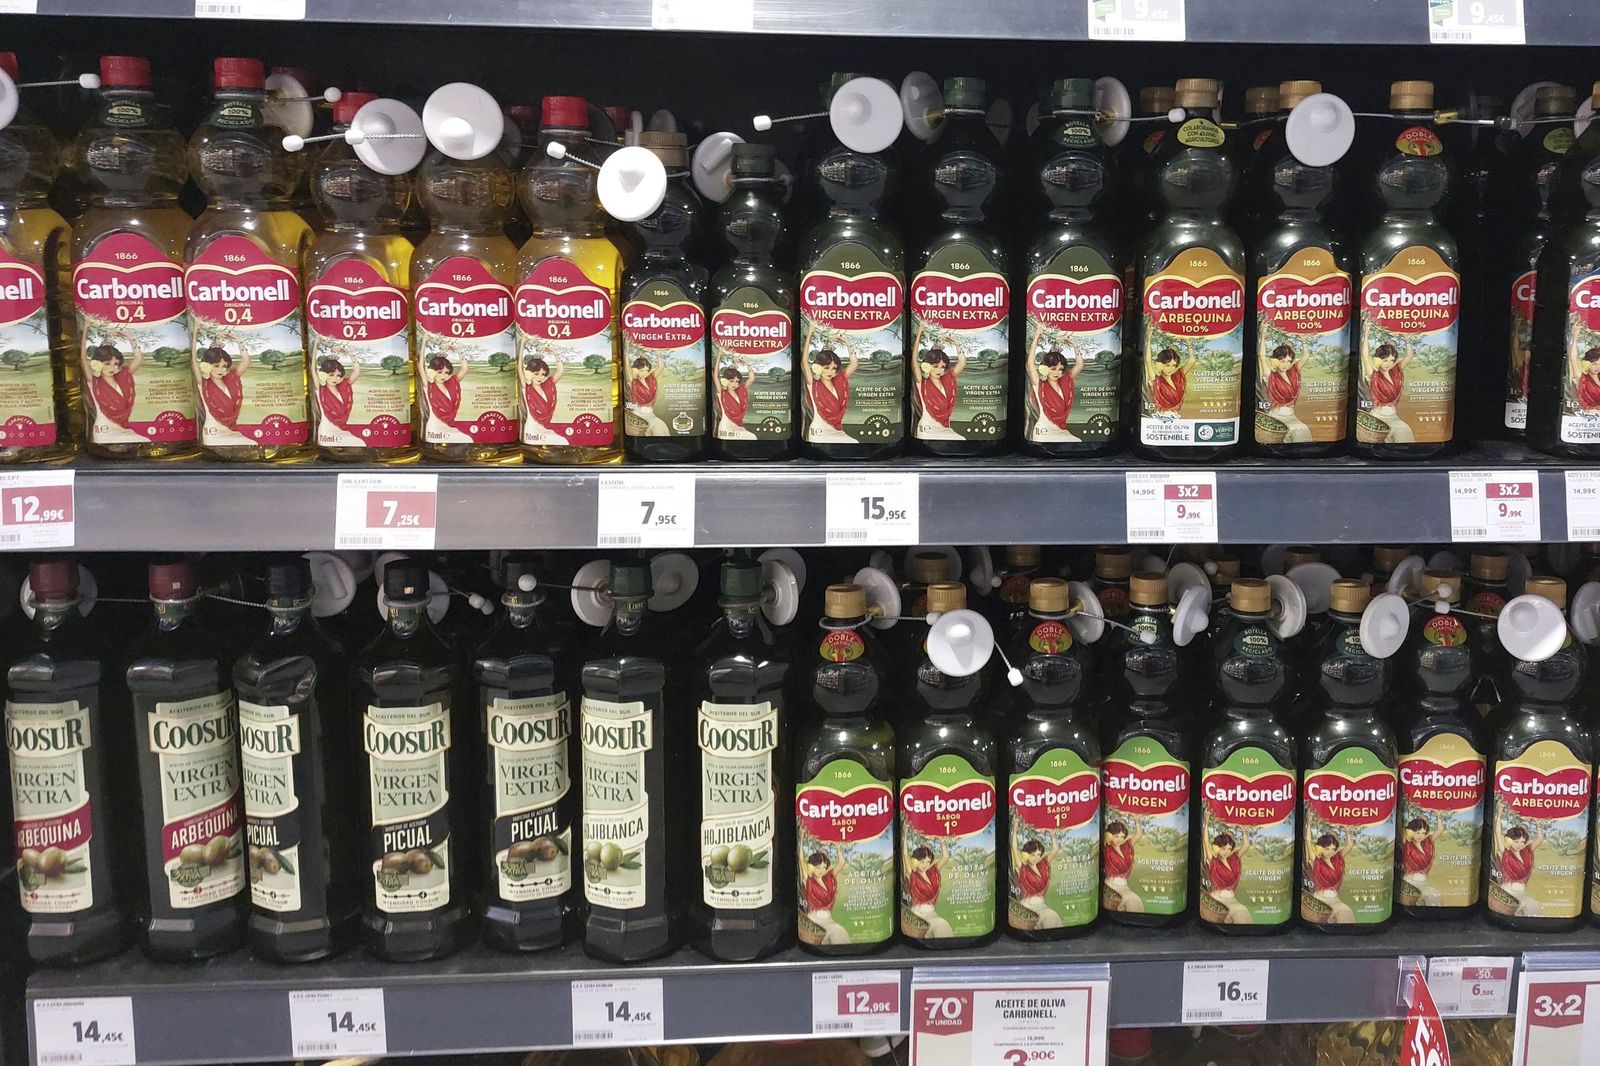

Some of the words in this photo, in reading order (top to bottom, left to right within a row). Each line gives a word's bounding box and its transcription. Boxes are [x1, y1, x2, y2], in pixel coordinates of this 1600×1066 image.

[115, 252, 138, 260] 1866
[223, 254, 246, 262] 1866
[1189, 260, 1208, 268] 1866
[1303, 259, 1321, 267] 1866
[840, 262, 861, 270] 1866
[950, 263, 970, 271] 1866
[1069, 264, 1089, 273] 1866
[343, 276, 364, 285] 1866
[452, 274, 473, 283] 1866
[548, 276, 568, 284] 1866
[77, 277, 184, 299] Carbonell
[188, 279, 290, 301] Carbonell
[653, 289, 669, 297] 1866
[804, 285, 896, 308] Carbonell
[915, 286, 1004, 307] Carbonell
[1031, 288, 1120, 309] Carbonell
[1148, 289, 1241, 309] Carbonell
[1261, 288, 1350, 308] Carbonell
[1365, 287, 1457, 307] Carbonell
[310, 299, 401, 320] Carbonell
[418, 296, 508, 318] Carbonell
[517, 298, 604, 320] Carbonell
[743, 301, 759, 309] 1866
[116, 306, 146, 322] 0,4
[224, 307, 253, 323] 0,4
[624, 312, 701, 329] Carbonell
[811, 309, 851, 320] VIRGEN
[854, 310, 891, 320] EXTRA
[921, 309, 961, 320] VIRGEN
[962, 310, 999, 320] EXTRA
[1038, 311, 1079, 322] VIRGEN
[1080, 311, 1115, 322] EXTRA
[1158, 313, 1232, 324] ARBEQUINA
[1273, 310, 1344, 321] ARBEQUINA
[1376, 309, 1450, 320] ARBEQUINA
[342, 324, 368, 340] 0,4
[451, 322, 476, 337] 0,4
[547, 324, 572, 339] 0,4
[715, 320, 787, 339] Carbonell
[1181, 325, 1209, 333] 100%
[1296, 322, 1323, 330] 100%
[1399, 321, 1426, 329] 100%
[632, 331, 663, 342] VIRGEN
[665, 331, 693, 341] EXTRA
[718, 338, 752, 348] VIRGEN
[752, 339, 784, 349] EXTRA
[1145, 433, 1190, 441] SOSTENIBLE
[1177, 485, 1199, 497] 3x2
[1498, 483, 1520, 496] 3x2
[11, 495, 64, 523] 12,99€
[383, 500, 420, 527] 7,25€
[640, 501, 677, 526] 7,95€
[860, 496, 906, 521] 15,95€
[1176, 504, 1201, 519] 9,99€
[1498, 502, 1522, 518] 9,99€
[1249, 636, 1267, 645] 100%
[153, 707, 237, 749] COOSUR
[491, 707, 570, 745] COOSUR
[366, 719, 447, 755] COOSUR
[699, 719, 774, 751] COOSUR
[1439, 743, 1456, 751] 1866
[1539, 751, 1556, 759] 1866
[500, 758, 564, 780] VIRGEN
[1050, 760, 1067, 768] 1866
[1242, 757, 1259, 765] 1866
[1346, 757, 1363, 765] 1866
[167, 759, 234, 785] VIRGEN
[706, 769, 766, 787] VIRGEN
[834, 771, 852, 779] 1866
[939, 766, 957, 774] 1866
[1400, 768, 1484, 788] Carbonell
[243, 771, 287, 789] IRGEN
[374, 770, 440, 791] VIRGEN
[505, 776, 562, 797] EXTRA
[1102, 769, 1186, 792] Carbonell
[1498, 774, 1588, 796] Carbonell
[174, 778, 234, 802] EXTRA
[244, 788, 284, 806] XTRA
[379, 789, 437, 807] EXTRA
[585, 783, 634, 802] EXTRA
[709, 785, 763, 803] EXTRA
[1012, 781, 1098, 807] Carbonell
[1205, 782, 1292, 803] Carbonell
[1307, 782, 1394, 803] Carbonell
[1412, 788, 1478, 801] ARBEQUINA
[799, 795, 889, 818] Carbonell
[903, 790, 992, 814] Carbonell
[1117, 794, 1168, 808] VIRGEN
[1512, 797, 1580, 809] ARBEQUINA
[936, 813, 961, 821] SABOR
[1046, 805, 1070, 814] SABOR
[1224, 806, 1275, 818] VIRGEN
[1328, 806, 1379, 818] VIRGEN
[171, 807, 238, 850] ARBEQUINA
[511, 812, 559, 843] PICUAL
[704, 815, 771, 845] HOJIBLANCA
[831, 818, 857, 826] SABOR
[247, 825, 280, 847] PICUAL
[383, 825, 433, 853] PICUAL
[1218, 981, 1258, 1002] 16,15€
[846, 991, 891, 1013] 12,99€
[995, 999, 1026, 1008] ACEITE
[1027, 999, 1039, 1008] DE
[1040, 998, 1066, 1008] OLIVA
[1534, 994, 1582, 1017] 3x2
[605, 1001, 652, 1022] 14,45€
[1003, 1009, 1057, 1019] CARBONELL.
[327, 1011, 376, 1033] 14,45€
[73, 1020, 124, 1043] 14,45€
